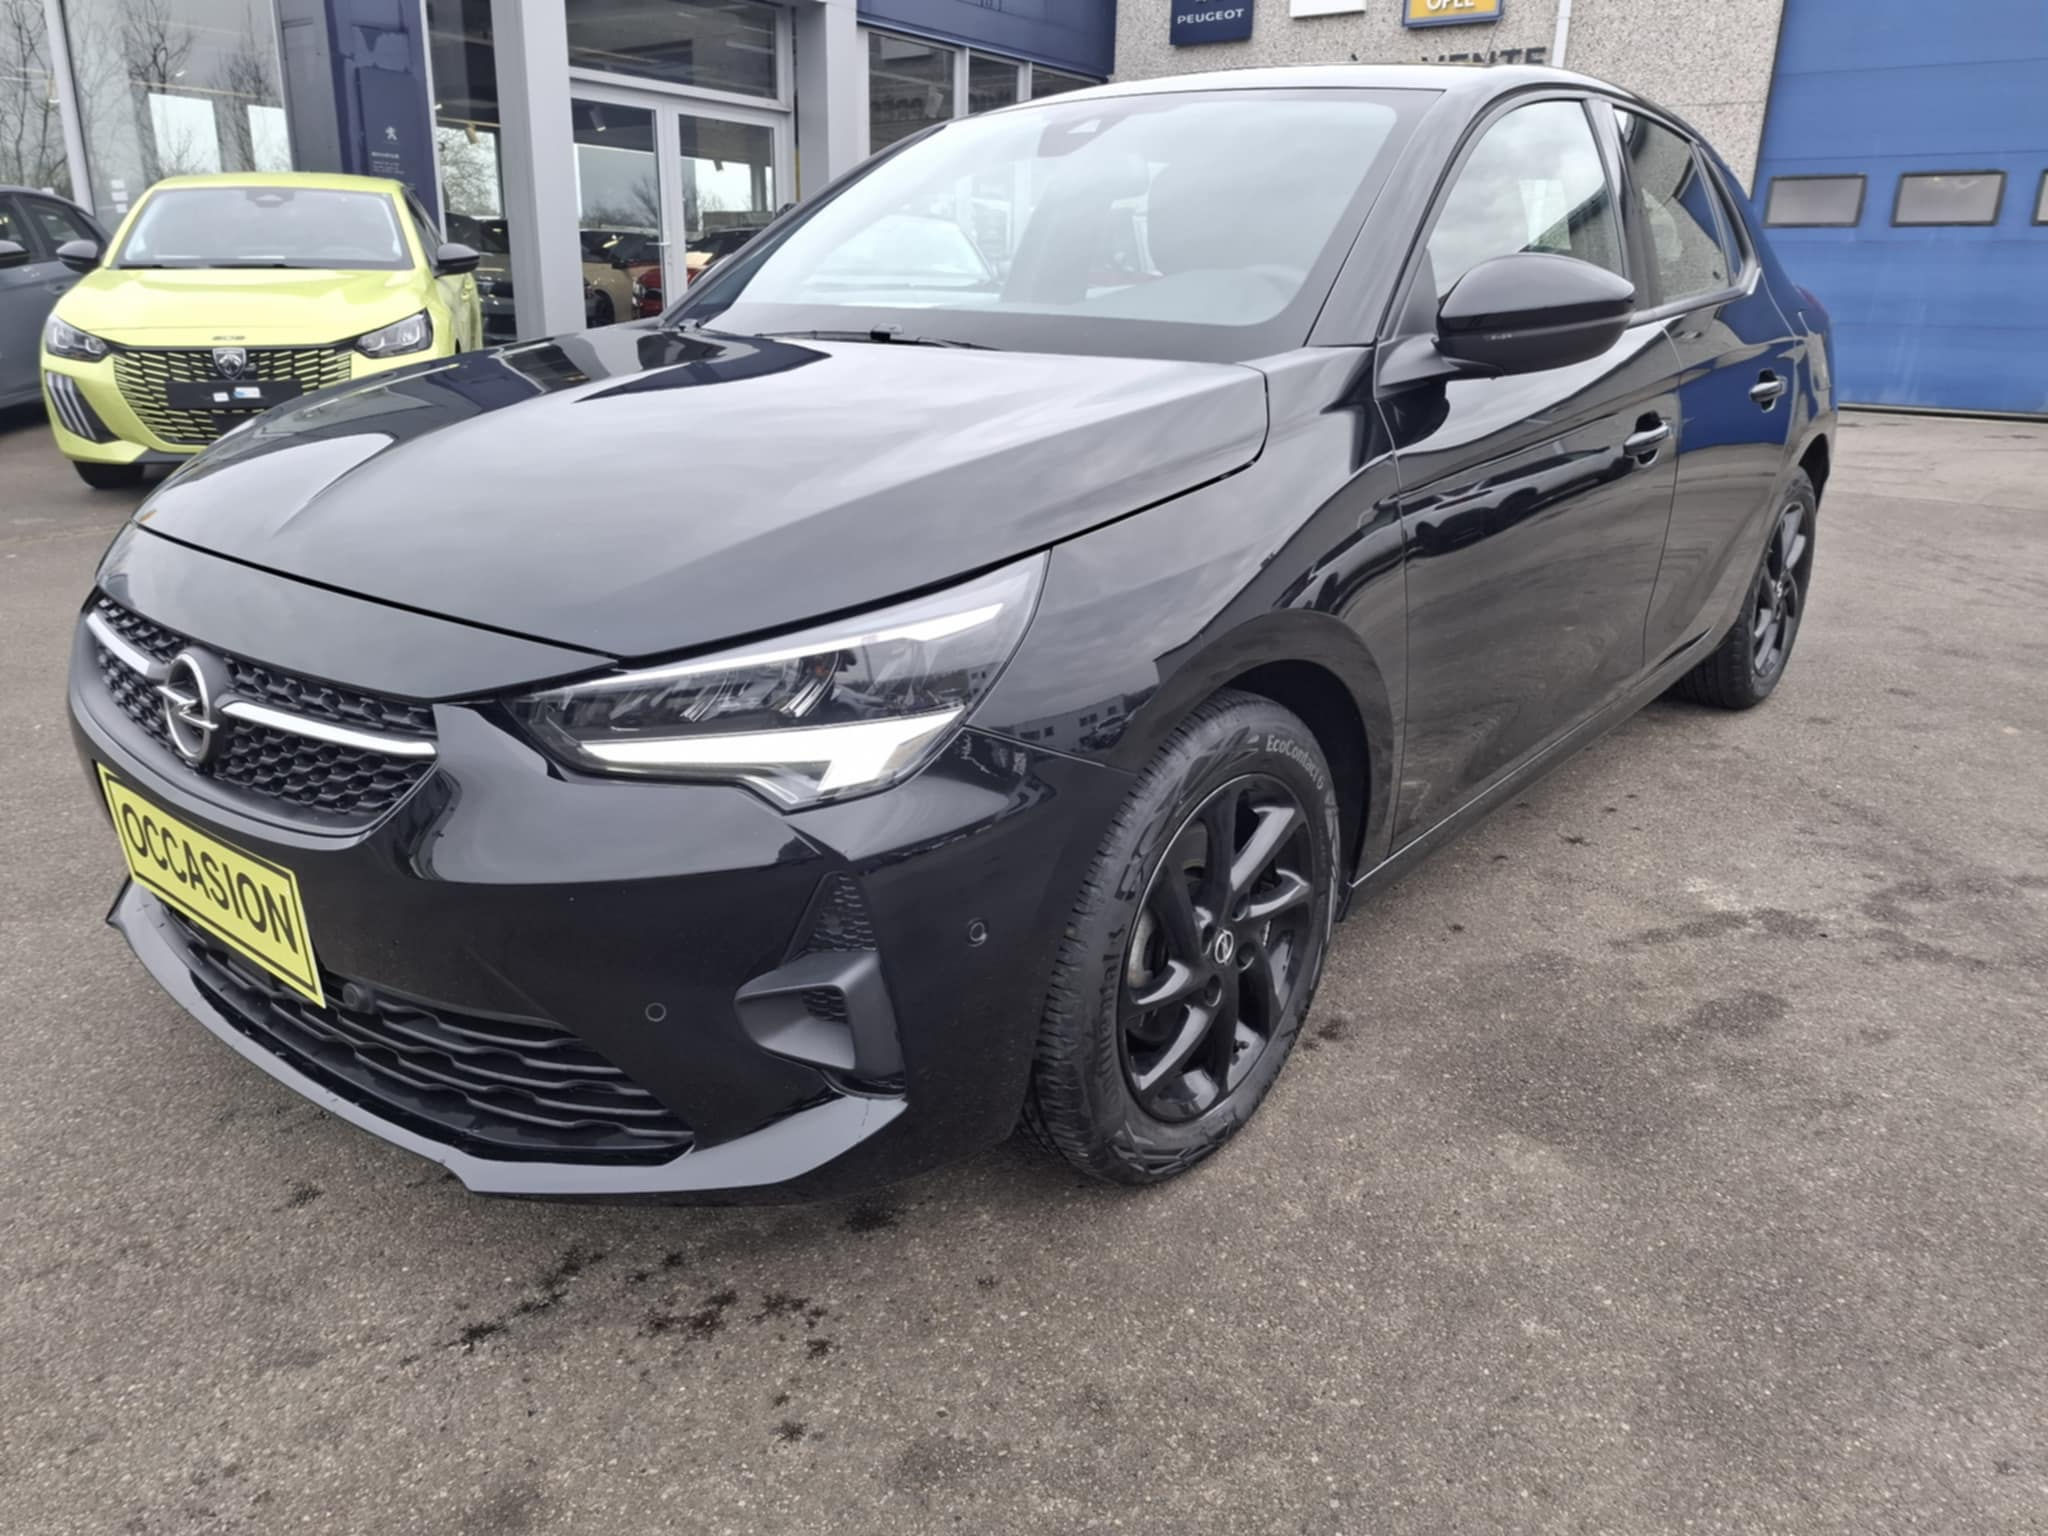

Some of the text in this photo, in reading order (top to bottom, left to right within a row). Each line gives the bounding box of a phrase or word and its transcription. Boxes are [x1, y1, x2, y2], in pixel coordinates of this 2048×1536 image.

[1177, 8, 1245, 24] PEUGEOT
[1265, 734, 1320, 783] EcoContact
[122, 803, 299, 955] OCCASION
